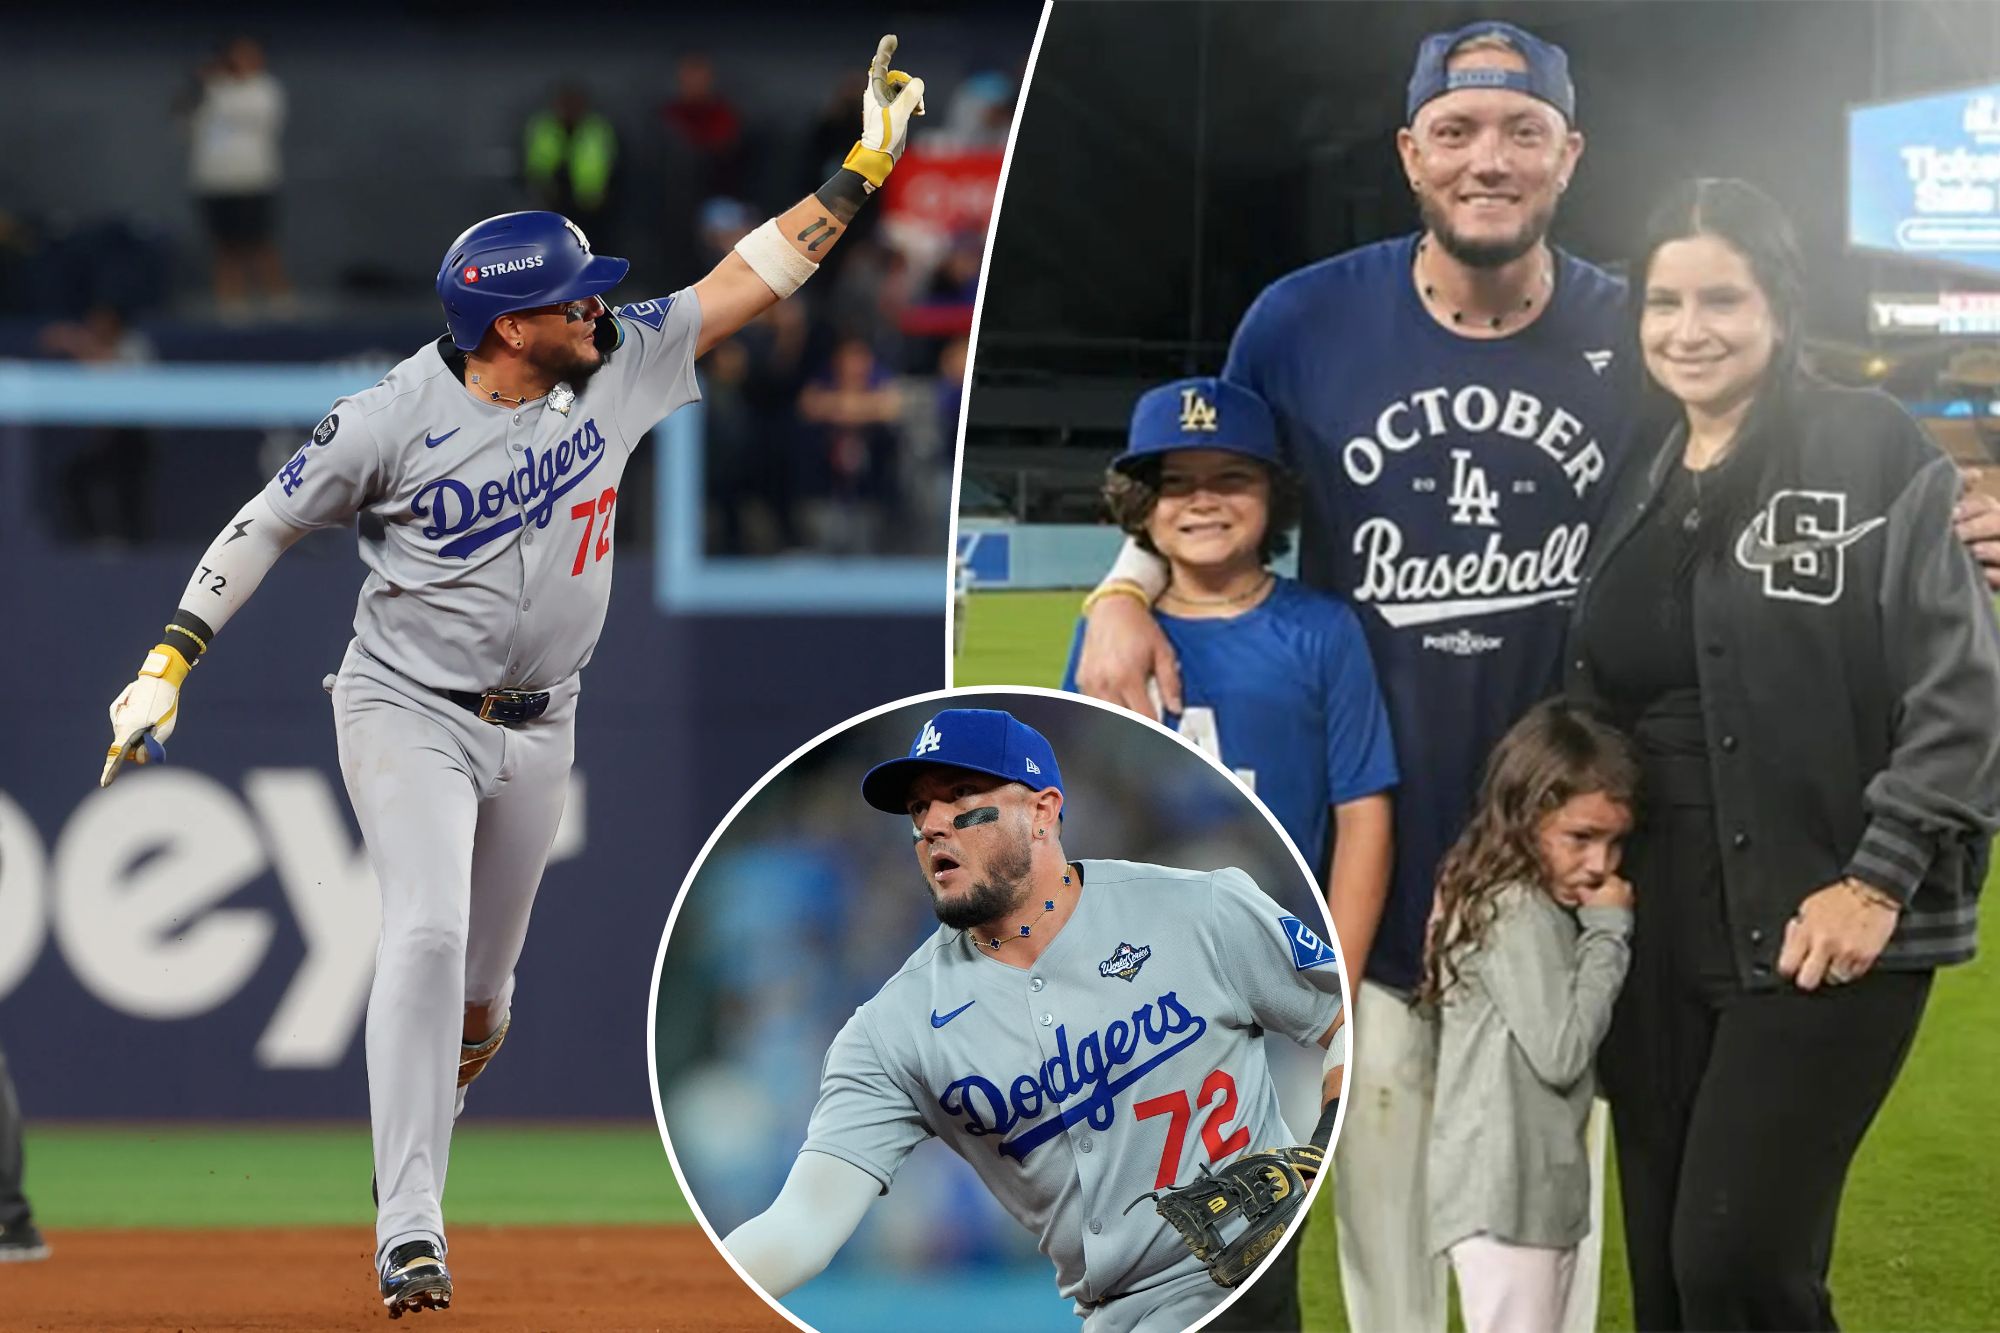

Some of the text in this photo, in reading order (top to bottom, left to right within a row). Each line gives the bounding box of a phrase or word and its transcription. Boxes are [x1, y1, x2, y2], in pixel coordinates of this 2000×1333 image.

[480, 255, 544, 279] STRAUSS
[1178, 387, 1218, 432] LA
[1342, 384, 1606, 497] OCTOBER
[411, 418, 606, 560] Dodgers
[1447, 448, 1500, 526] LA
[571, 486, 618, 577] 72
[1351, 517, 1590, 606] Baseball
[198, 566, 228, 597] 72
[916, 719, 942, 757] LA
[1100, 953, 1130, 976] World
[939, 991, 1207, 1162] Dodgers
[1133, 1069, 1251, 1191] 72
